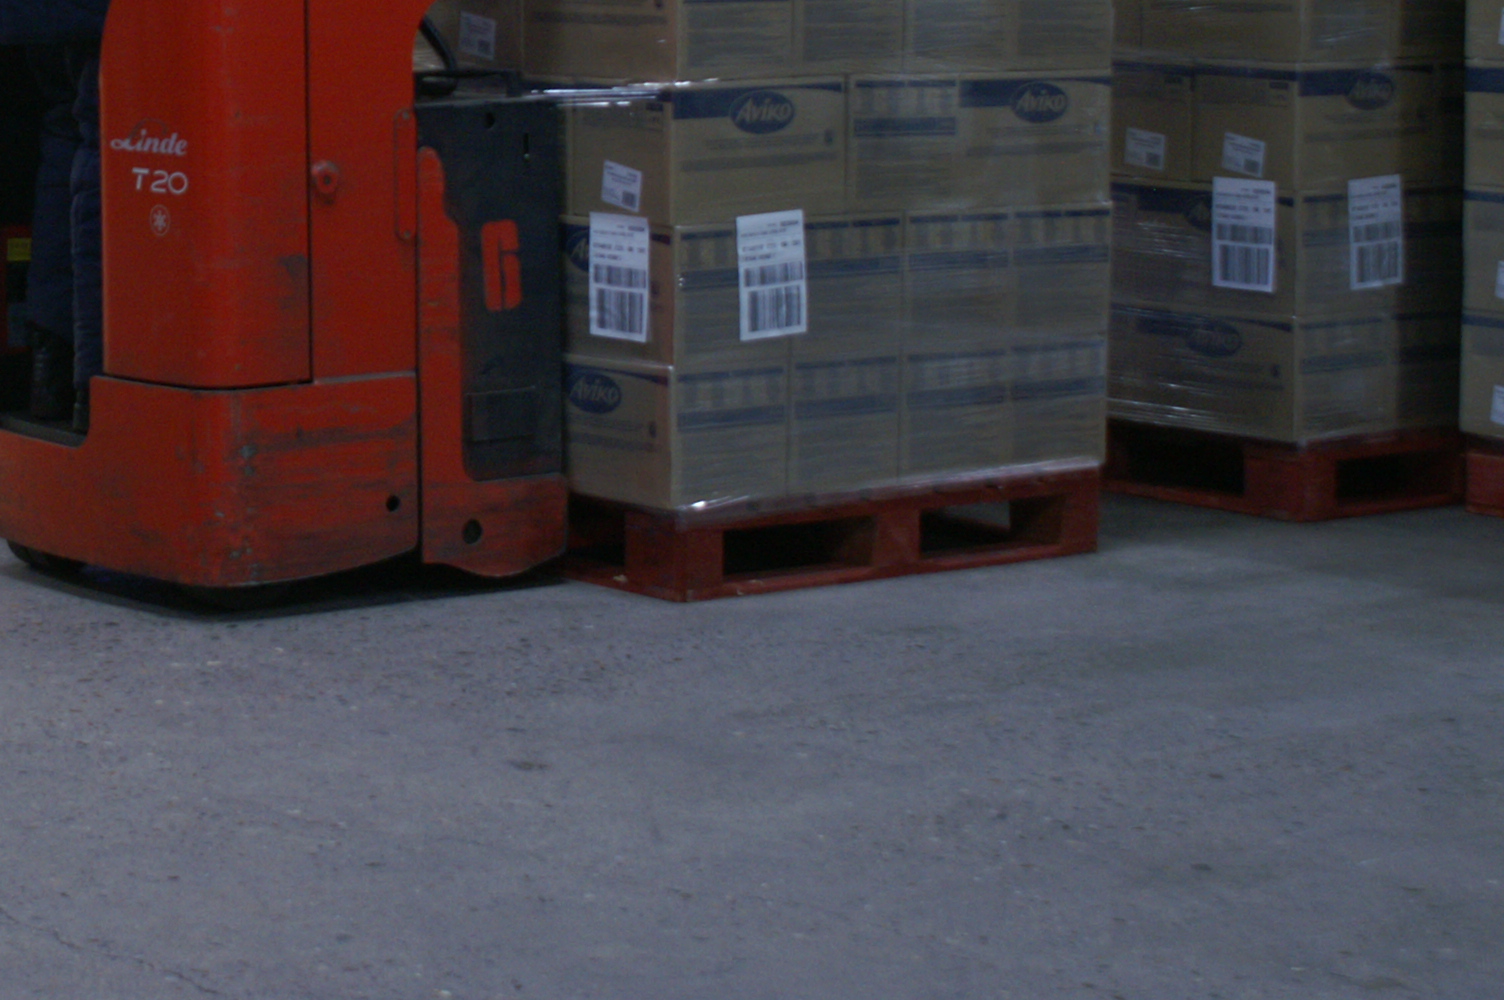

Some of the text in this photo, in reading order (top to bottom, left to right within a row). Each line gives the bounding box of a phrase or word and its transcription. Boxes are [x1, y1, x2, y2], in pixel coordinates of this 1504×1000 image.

[733, 94, 793, 126] Aviko
[1014, 86, 1066, 116] Aviko
[110, 119, 188, 156] Linde
[132, 166, 189, 195] T20
[570, 375, 620, 405] Aviko
